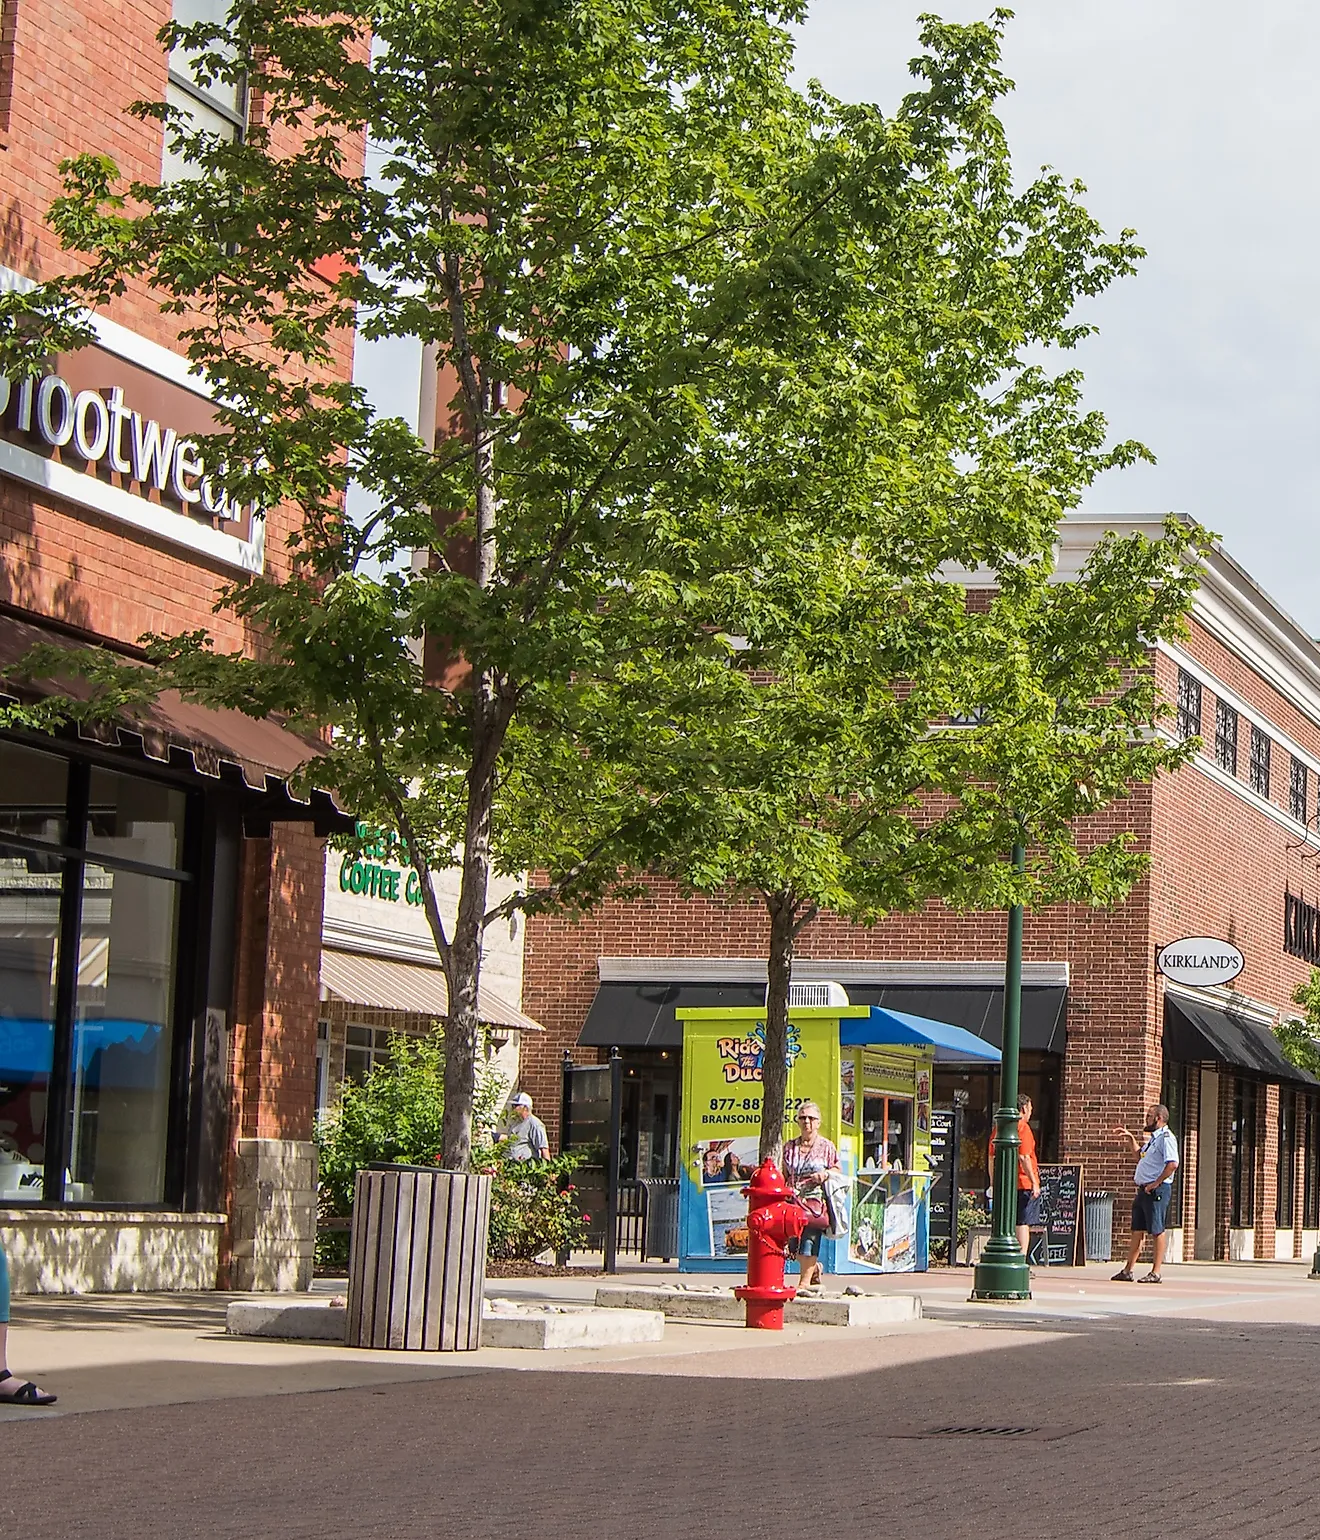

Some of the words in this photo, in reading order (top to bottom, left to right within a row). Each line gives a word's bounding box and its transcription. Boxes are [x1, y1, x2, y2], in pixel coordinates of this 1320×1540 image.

[340, 857, 400, 902] COFFEE
[1163, 953, 1240, 970] KIRKLAND'S
[717, 1038, 761, 1059] Ride
[740, 1056, 755, 1067] The
[722, 1062, 764, 1083] Duc
[1040, 1247, 1068, 1258] CFFEE
